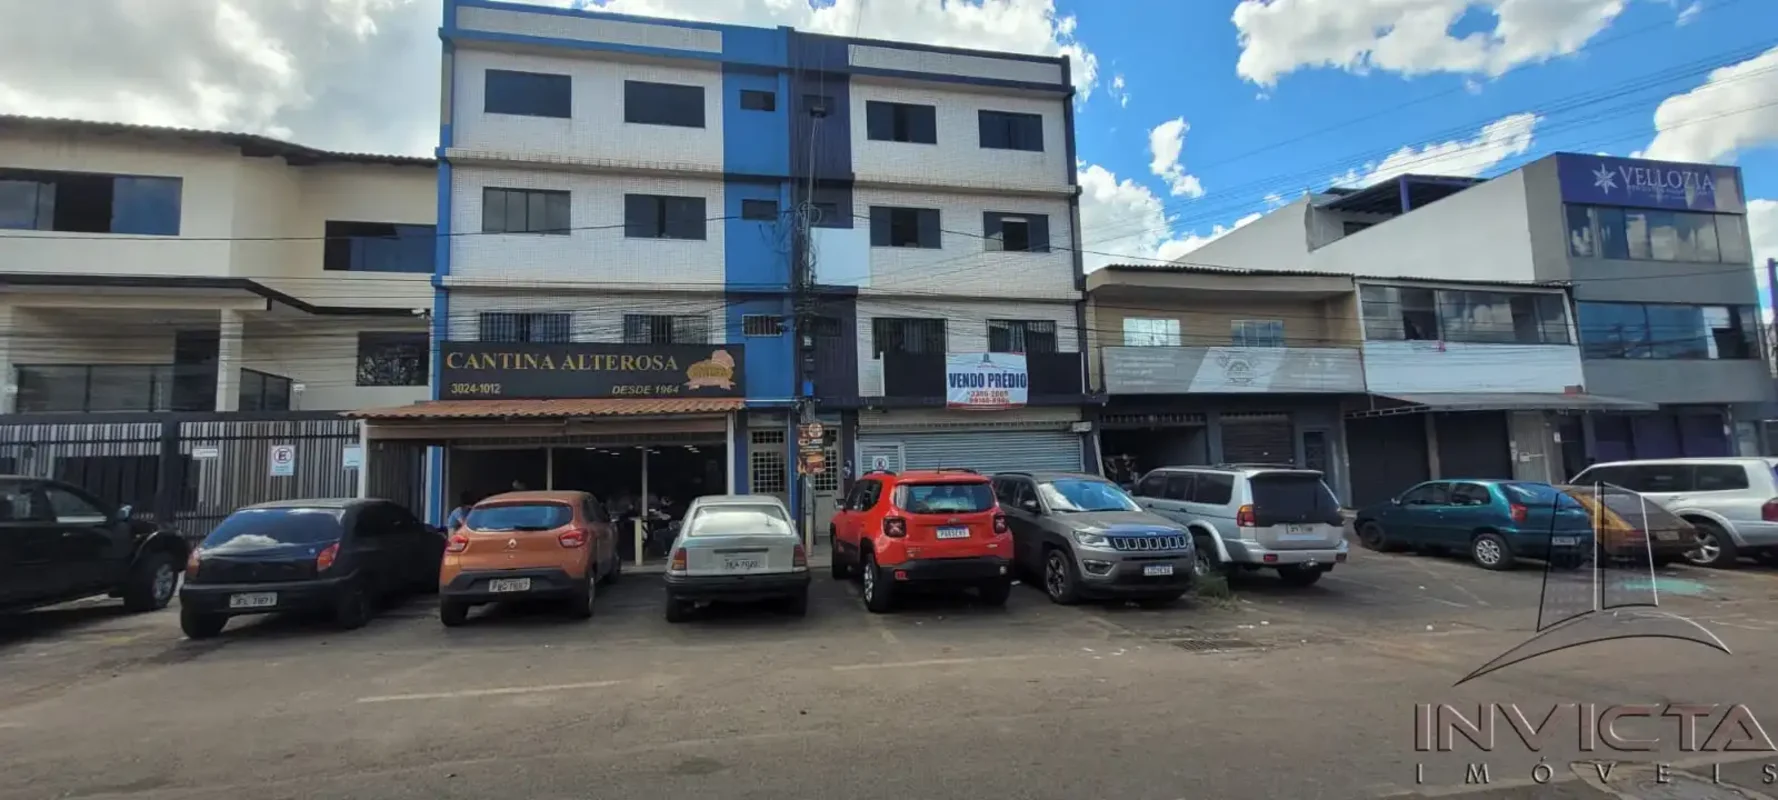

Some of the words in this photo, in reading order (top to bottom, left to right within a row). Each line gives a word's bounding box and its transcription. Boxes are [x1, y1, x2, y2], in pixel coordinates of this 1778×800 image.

[1619, 165, 1715, 191] VELLOZIA
[447, 351, 556, 370] CANTINA
[560, 353, 679, 371] ALTEROSA
[949, 372, 985, 388] VENDO
[988, 370, 1027, 388] PRÉDIO
[451, 383, 501, 394] 3024-1012
[611, 385, 652, 395] DESDE
[655, 384, 679, 394] 1964
